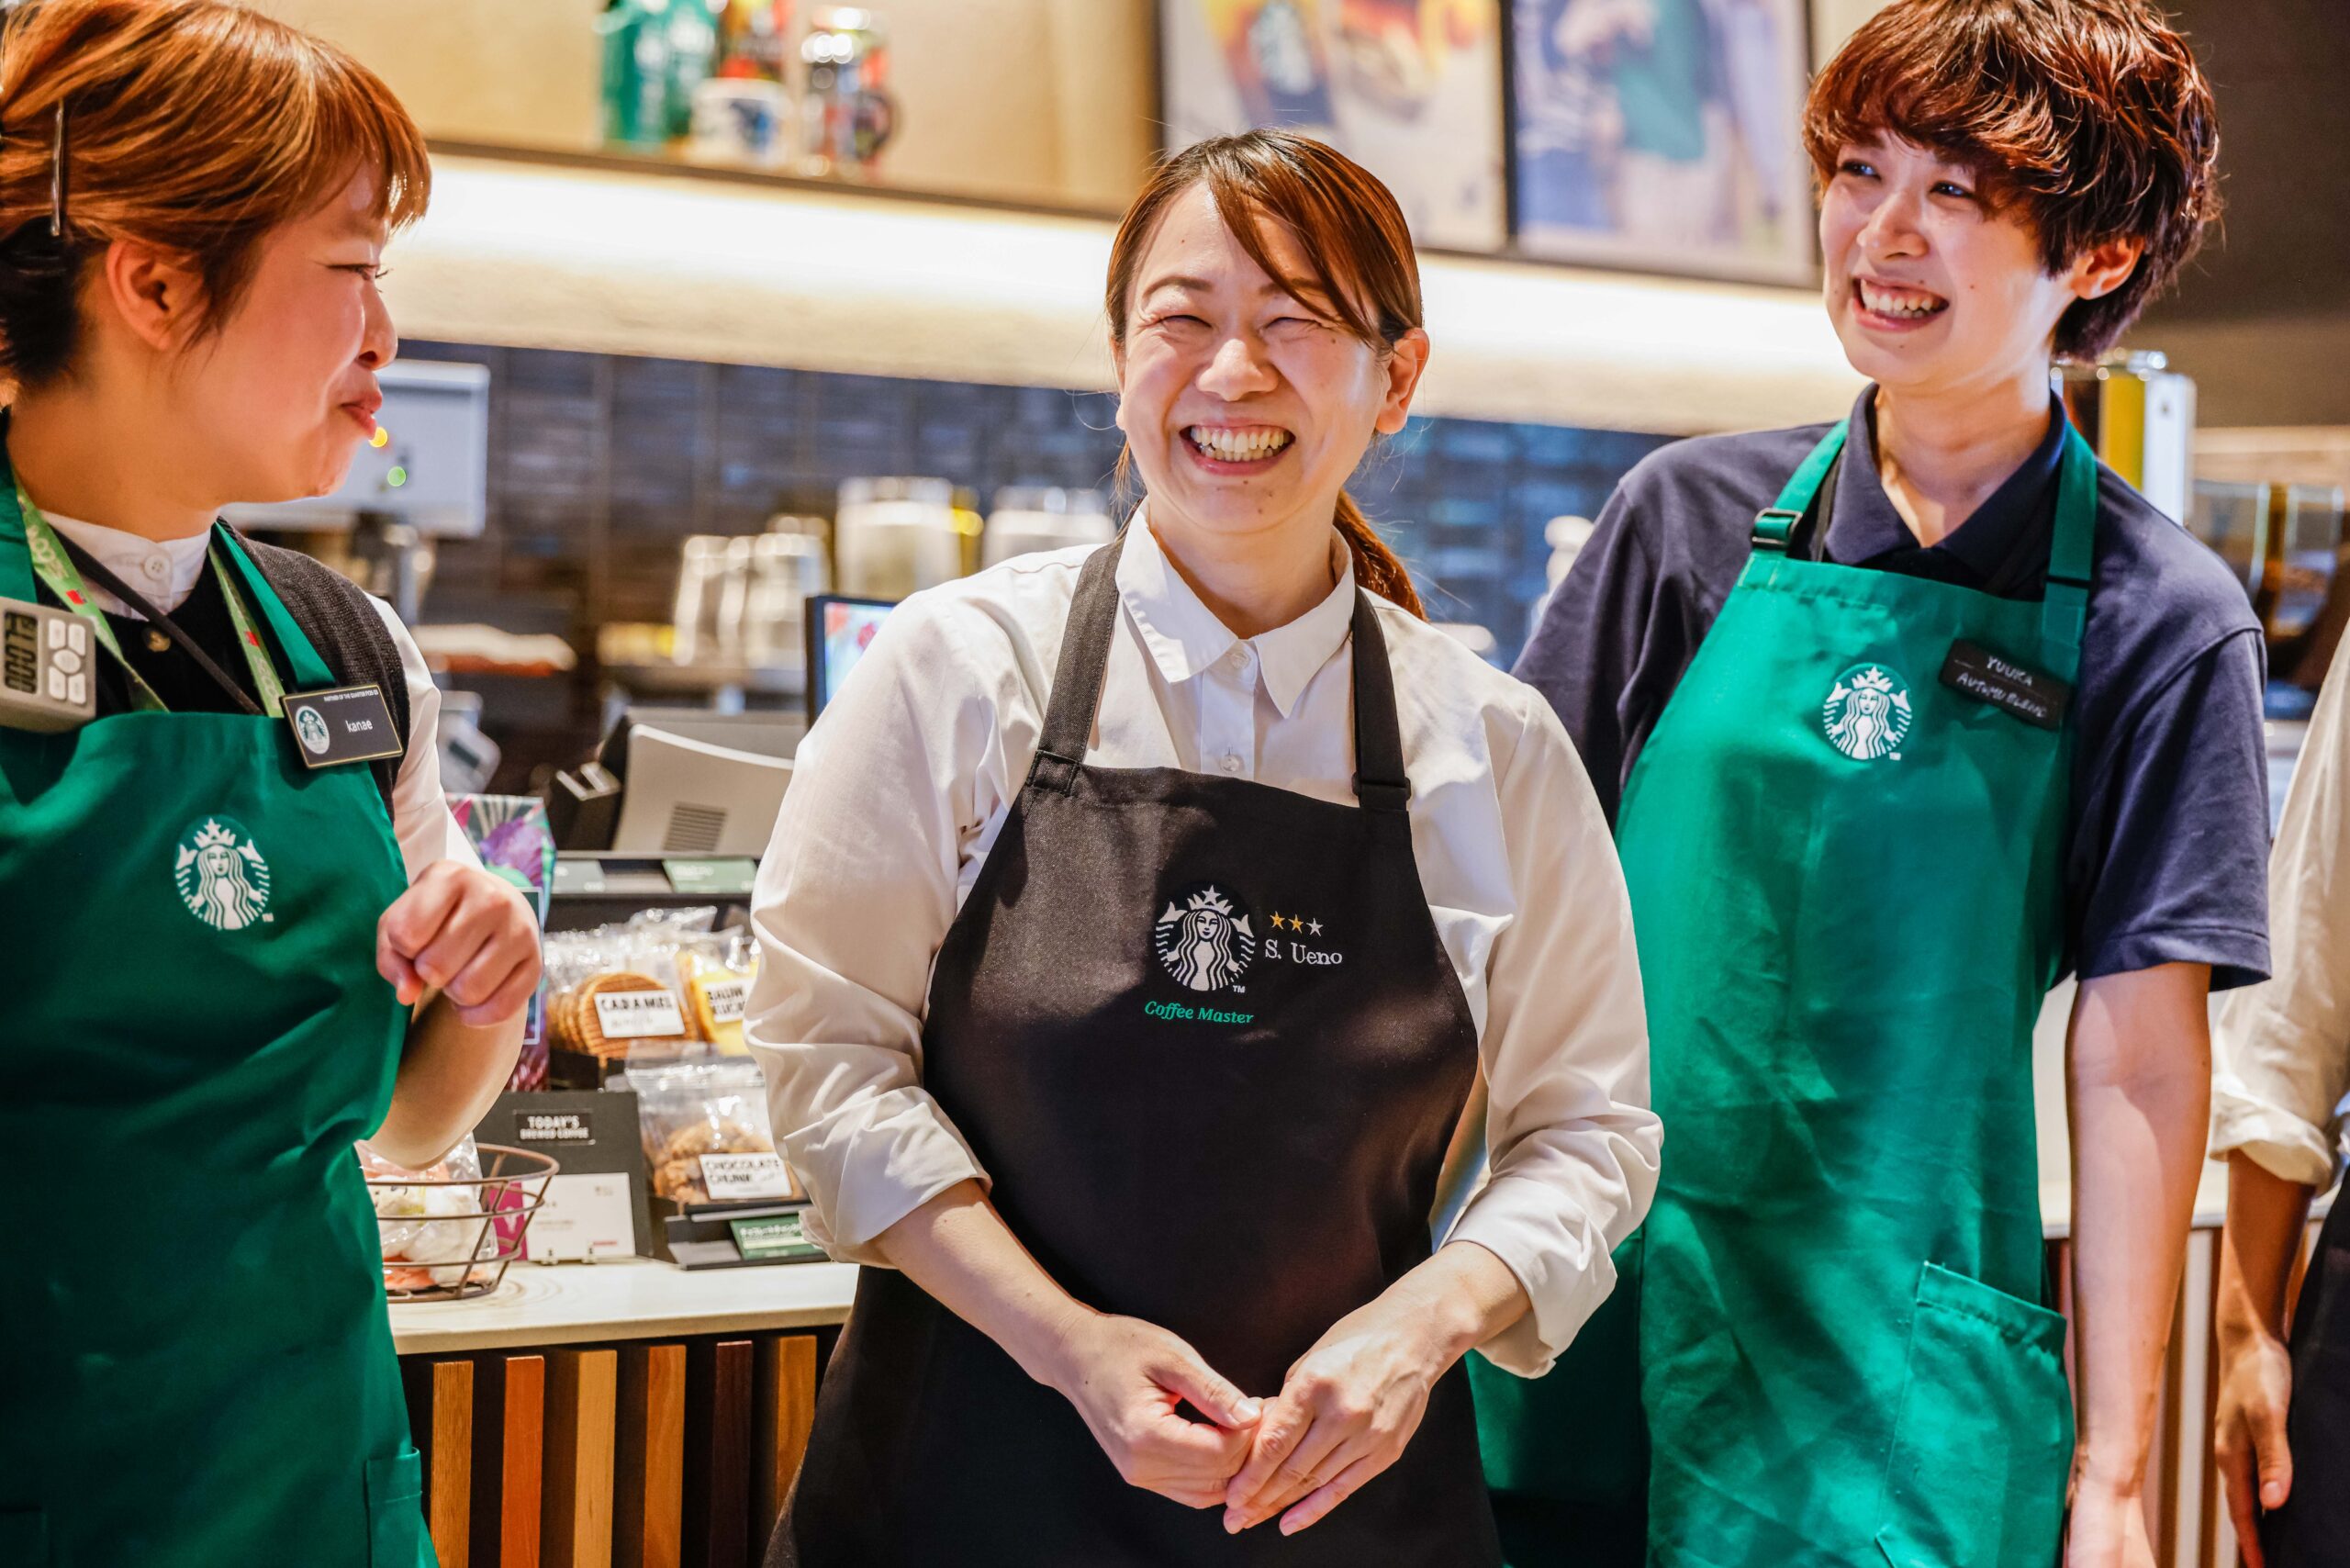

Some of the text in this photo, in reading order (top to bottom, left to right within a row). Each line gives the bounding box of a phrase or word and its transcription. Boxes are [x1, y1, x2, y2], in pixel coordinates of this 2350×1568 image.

[1986, 655, 2032, 687] YUUKA
[345, 720, 374, 733] kanae
[1265, 938, 1343, 965] S. Ueno
[1145, 1000, 1254, 1025] Coffee Master
[527, 1114, 580, 1130] TODAY'S
[556, 1126, 589, 1139] COFFEE
